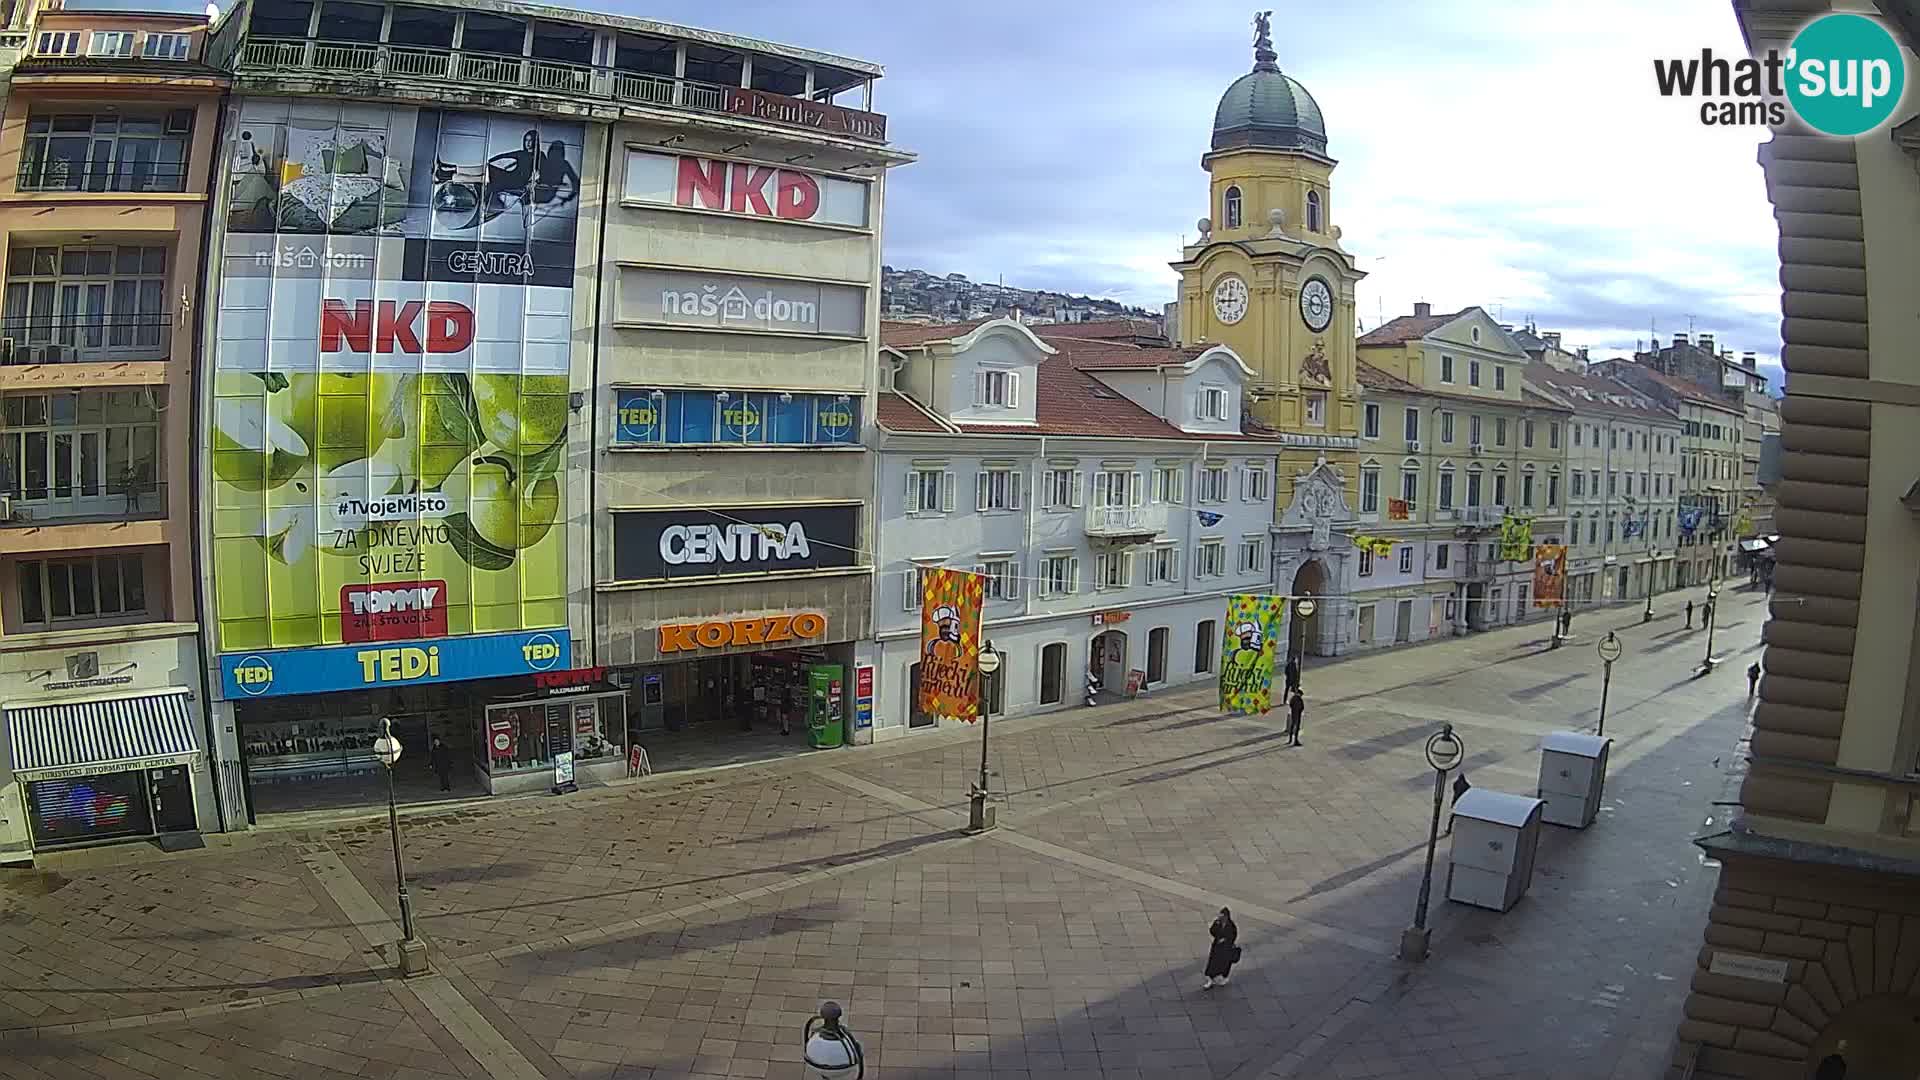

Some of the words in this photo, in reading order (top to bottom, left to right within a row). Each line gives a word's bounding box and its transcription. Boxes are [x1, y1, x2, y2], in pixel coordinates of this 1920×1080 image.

[723, 89, 745, 112] Le
[676, 155, 821, 221] NKD
[255, 246, 295, 268] naš
[319, 246, 365, 269] dom
[447, 250, 534, 276] CENTRA
[661, 285, 719, 317] naš
[753, 290, 817, 323] dom
[321, 299, 476, 353] NKD
[619, 408, 658, 425] TEDi
[723, 409, 760, 426] TEDi
[820, 412, 853, 427] TEDi
[337, 498, 446, 517] #TvojeMisto
[333, 528, 358, 549] ZA
[367, 524, 450, 549] DNEVNO
[659, 522, 811, 565] CENTRA
[358, 548, 427, 576] SVJEŽE
[348, 587, 439, 615] TOMMY
[659, 612, 826, 653] KORZO
[522, 642, 561, 660] TEDi
[233, 665, 274, 685] TEDi
[357, 646, 440, 683] TEDi
